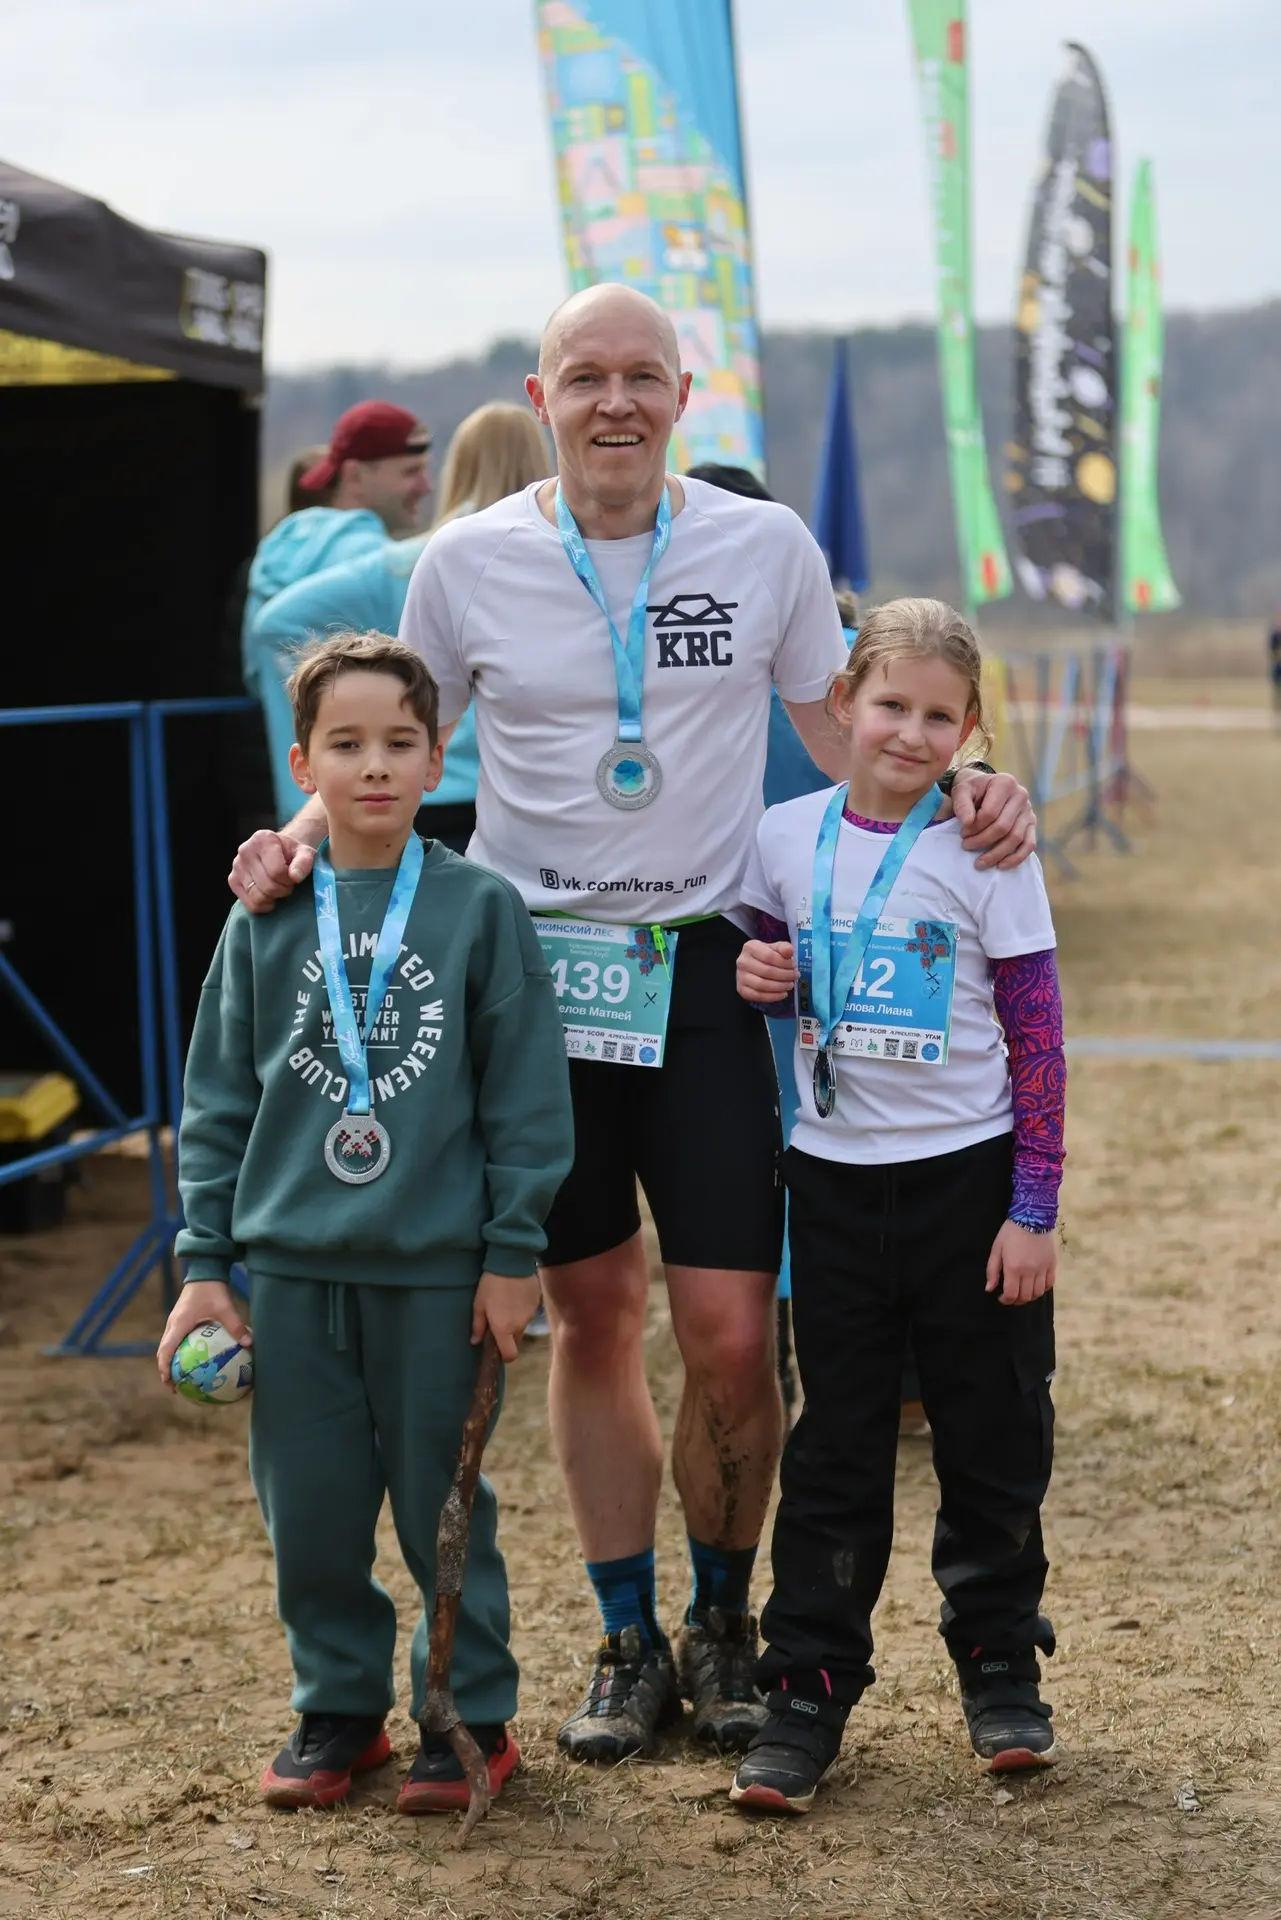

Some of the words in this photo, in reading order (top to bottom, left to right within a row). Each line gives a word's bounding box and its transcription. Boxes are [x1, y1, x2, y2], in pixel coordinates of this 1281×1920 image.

[656, 631, 733, 668] KRC
[562, 875, 707, 894] vk.com/kras_run
[535, 922, 591, 935] МКИНСКИЙ
[593, 928, 614, 937] ЛЕС
[550, 959, 630, 1004] 439
[288, 990, 310, 1043] THE
[558, 1004, 586, 1015] елов
[589, 1006, 632, 1021] Матвей
[845, 1002, 875, 1014] елова
[876, 1003, 913, 1017] Лиана
[368, 999, 444, 1104] WEEKEN
[288, 1047, 348, 1103] CLUB
[981, 1661, 1009, 1673] GSD
[790, 1698, 819, 1714] GSD
